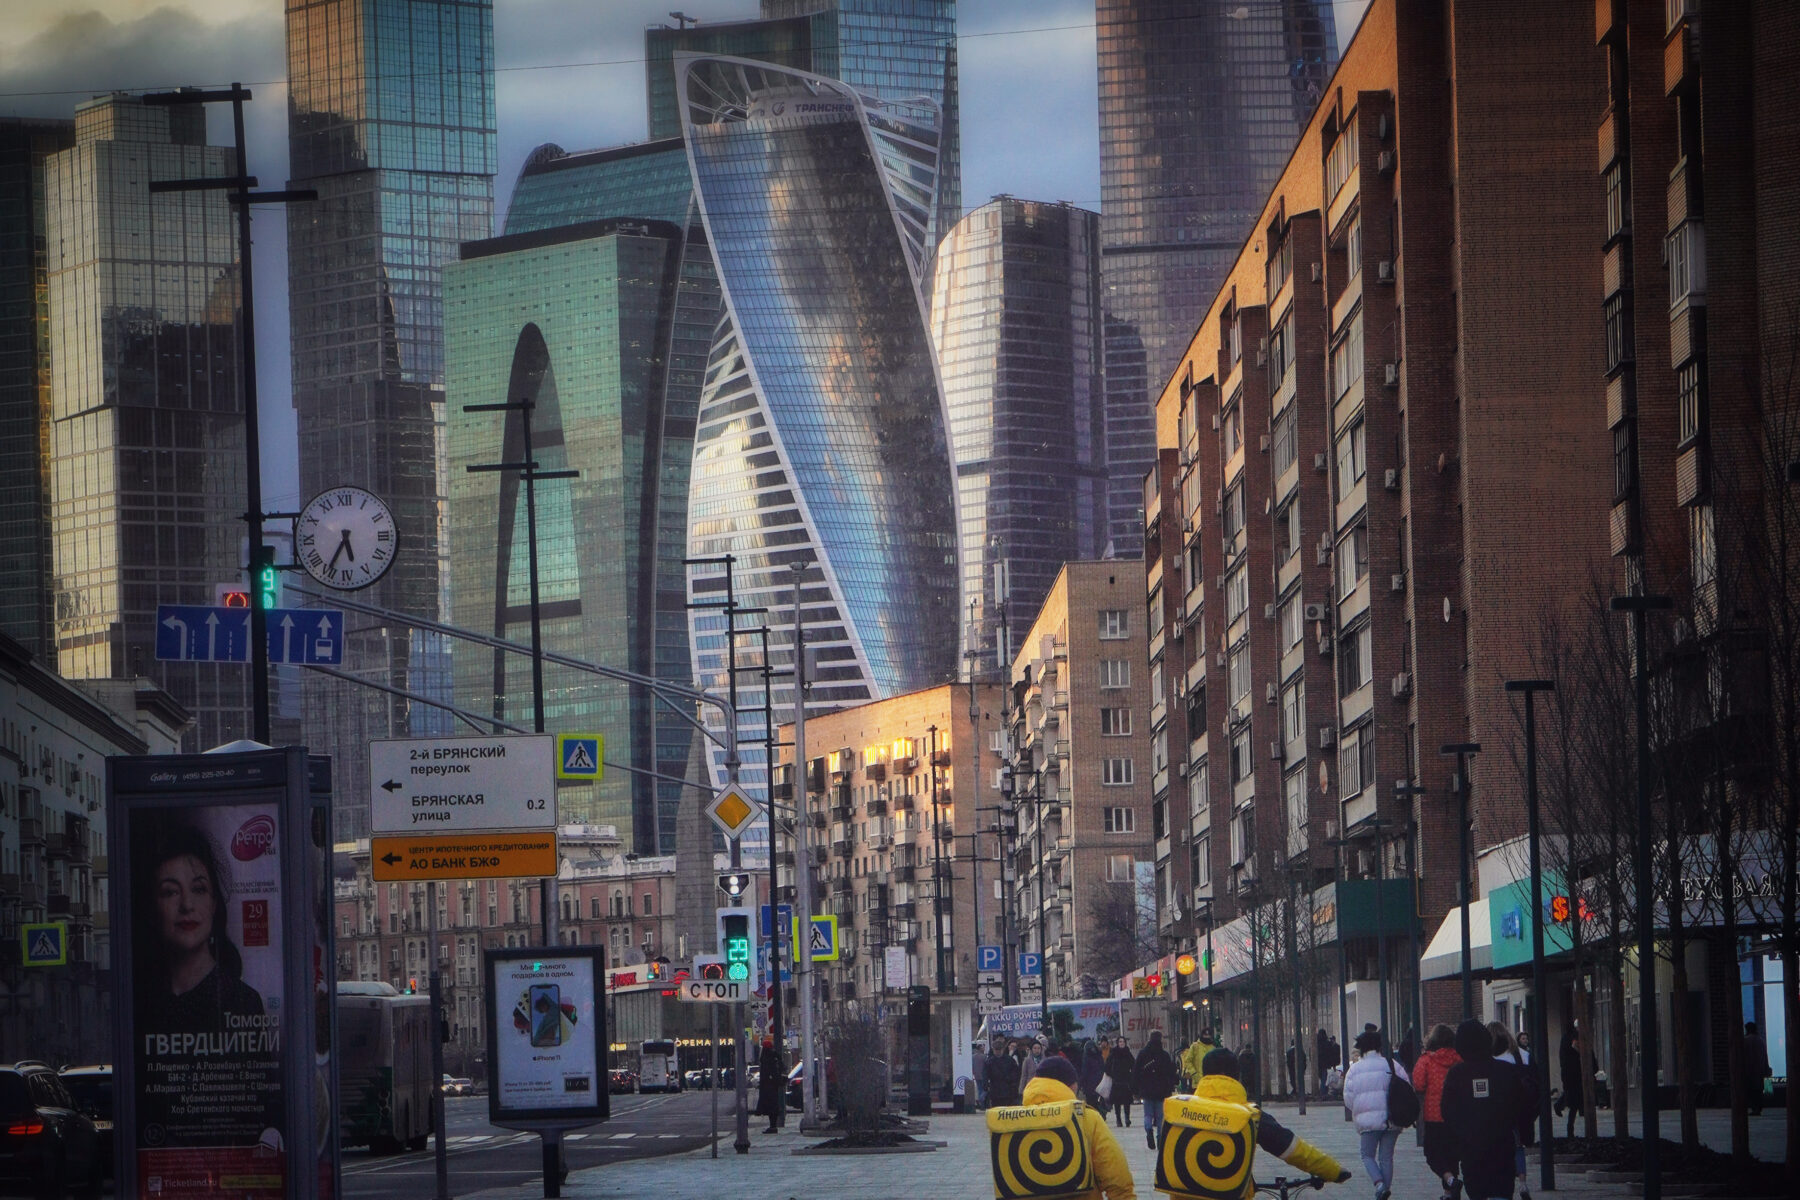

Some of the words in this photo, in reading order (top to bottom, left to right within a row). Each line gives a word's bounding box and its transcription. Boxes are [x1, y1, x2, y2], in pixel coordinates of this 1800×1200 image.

[319, 499, 333, 514] XI
[338, 495, 352, 506] XII
[360, 499, 367, 510] I
[307, 515, 319, 526] X
[372, 512, 384, 523] II
[303, 534, 314, 546] IX
[378, 531, 389, 541] III
[308, 549, 323, 568] VIII
[322, 564, 337, 579] VII
[360, 563, 371, 576] V
[410, 750, 430, 761] 2-й
[434, 745, 506, 760] БРЯНСКИЙ
[410, 765, 470, 777] переулок
[150, 772, 177, 784] Gallery
[412, 794, 484, 807] БРЯНСКАЯ
[527, 799, 546, 810] 0.2
[412, 813, 451, 824] улица
[236, 830, 273, 848] Ретро
[409, 847, 434, 855] ЦЕНТР
[436, 845, 487, 854] ИПОТЕЧНОГО
[489, 843, 550, 852] КРЕДИТОВАНИЯ
[409, 859, 428, 870] АО
[432, 858, 466, 869] БАНК
[469, 857, 500, 868] БЖФ
[248, 903, 263, 919] 29
[729, 938, 748, 961] 29
[984, 948, 997, 968] P
[1025, 955, 1038, 973] P
[1179, 959, 1191, 969] 24
[520, 963, 566, 971] Мноо-много
[690, 983, 739, 998] СТОП
[1013, 1011, 1043, 1020] POWER
[1080, 1005, 1113, 1018] STIHL
[224, 1011, 280, 1032] Тамара
[1014, 1022, 1025, 1030] BY
[1128, 1017, 1163, 1031] STIHL
[145, 1030, 280, 1057] ГВЕРДЦИТЕЛИ
[675, 1038, 734, 1047] ОФЕМАИЯ
[168, 1073, 186, 1082] БИ-2
[171, 1105, 185, 1114] Хор
[998, 1109, 1037, 1120] Яндекс
[1041, 1107, 1061, 1117] Еда
[1181, 1107, 1211, 1123] Яндекс
[1213, 1112, 1229, 1126] Еда
